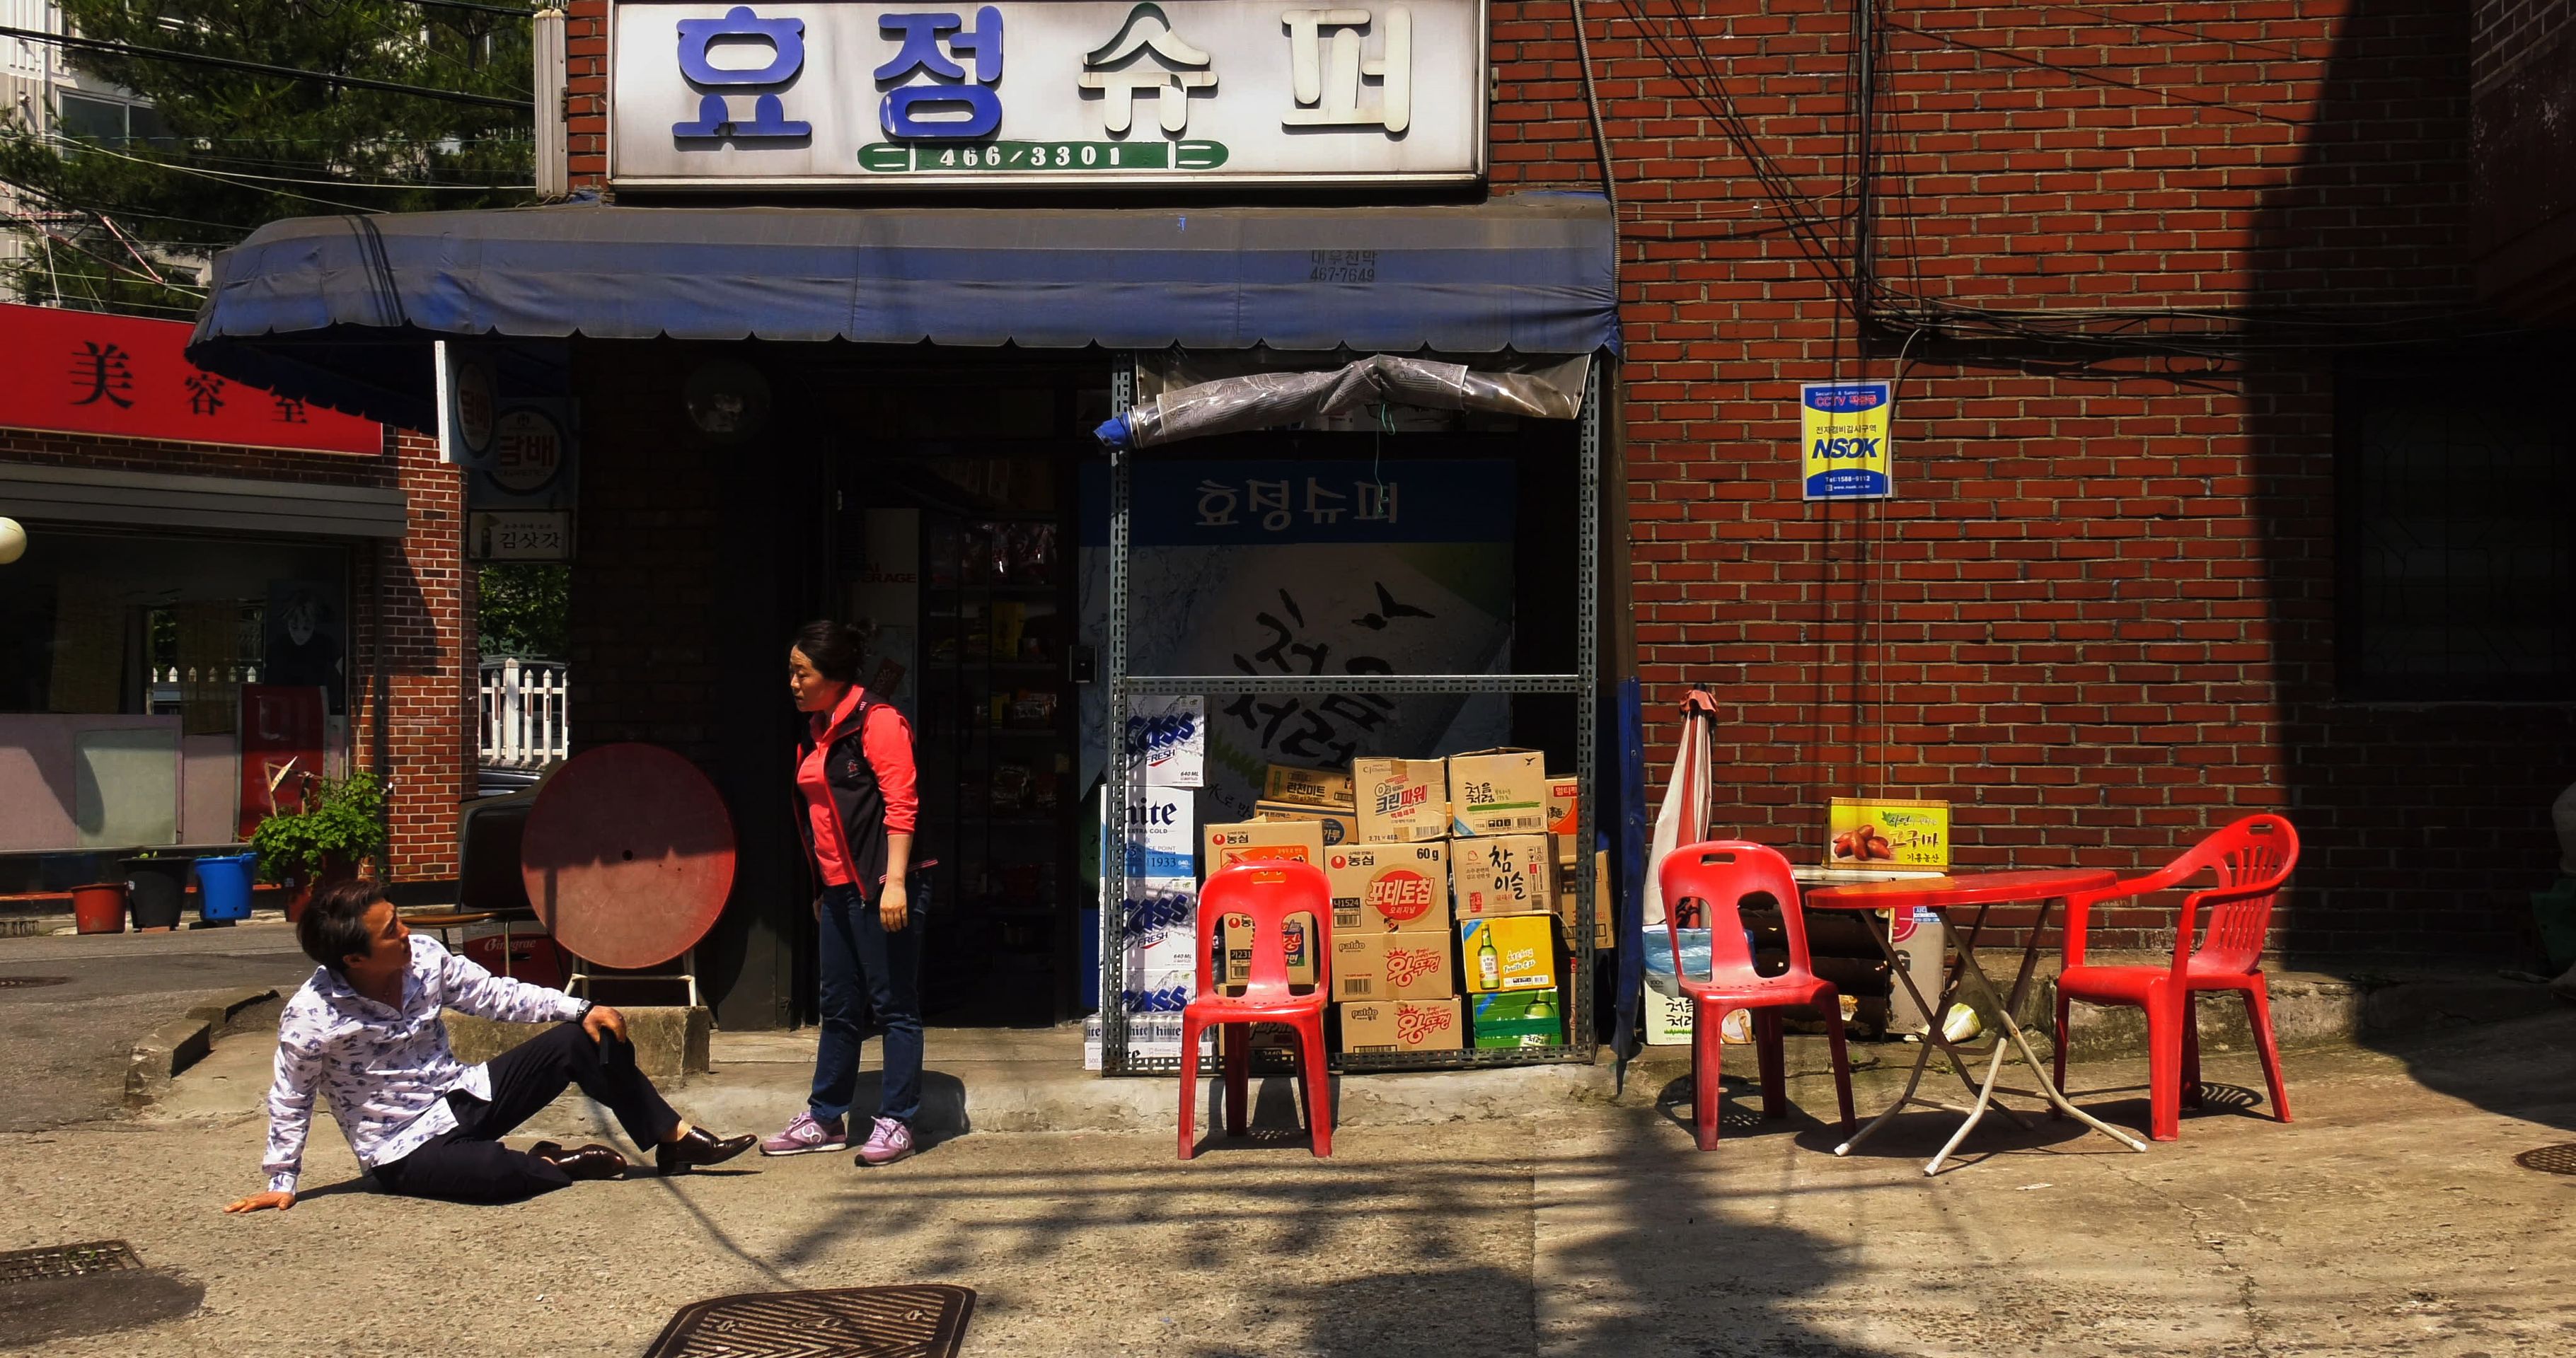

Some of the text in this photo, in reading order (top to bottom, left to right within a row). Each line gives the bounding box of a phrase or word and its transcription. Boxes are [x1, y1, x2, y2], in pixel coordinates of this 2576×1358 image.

[1310, 267, 1375, 282] 467-7649
[1815, 396, 1846, 407] CCTV
[499, 435, 555, 467] 담배
[1811, 438, 1881, 459] NSOK
[499, 532, 560, 550] 김삿갓
[1145, 750, 1176, 764] FRESH
[1465, 782, 1491, 794] 처음
[1375, 784, 1428, 816] 크린파워
[1465, 794, 1495, 803] 처럼
[1227, 835, 1249, 845] 농심
[1888, 830, 1939, 849] 고구마
[1348, 855, 1374, 866] 농심
[1416, 848, 1439, 861] 60 g
[1488, 845, 1514, 873] 참
[1151, 857, 1176, 867] 1933
[1365, 877, 1435, 906] 포테토칩
[1494, 871, 1527, 900] 이슬
[1390, 906, 1416, 915] 오리지널
[1138, 932, 1168, 948] FRESH
[1339, 940, 1365, 953] paldo
[1387, 956, 1441, 987] 왕뚜껑
[1351, 1007, 1379, 1020] paldo
[1087, 1026, 1101, 1037] ite
[1397, 1013, 1451, 1045] 왕뚜껑
